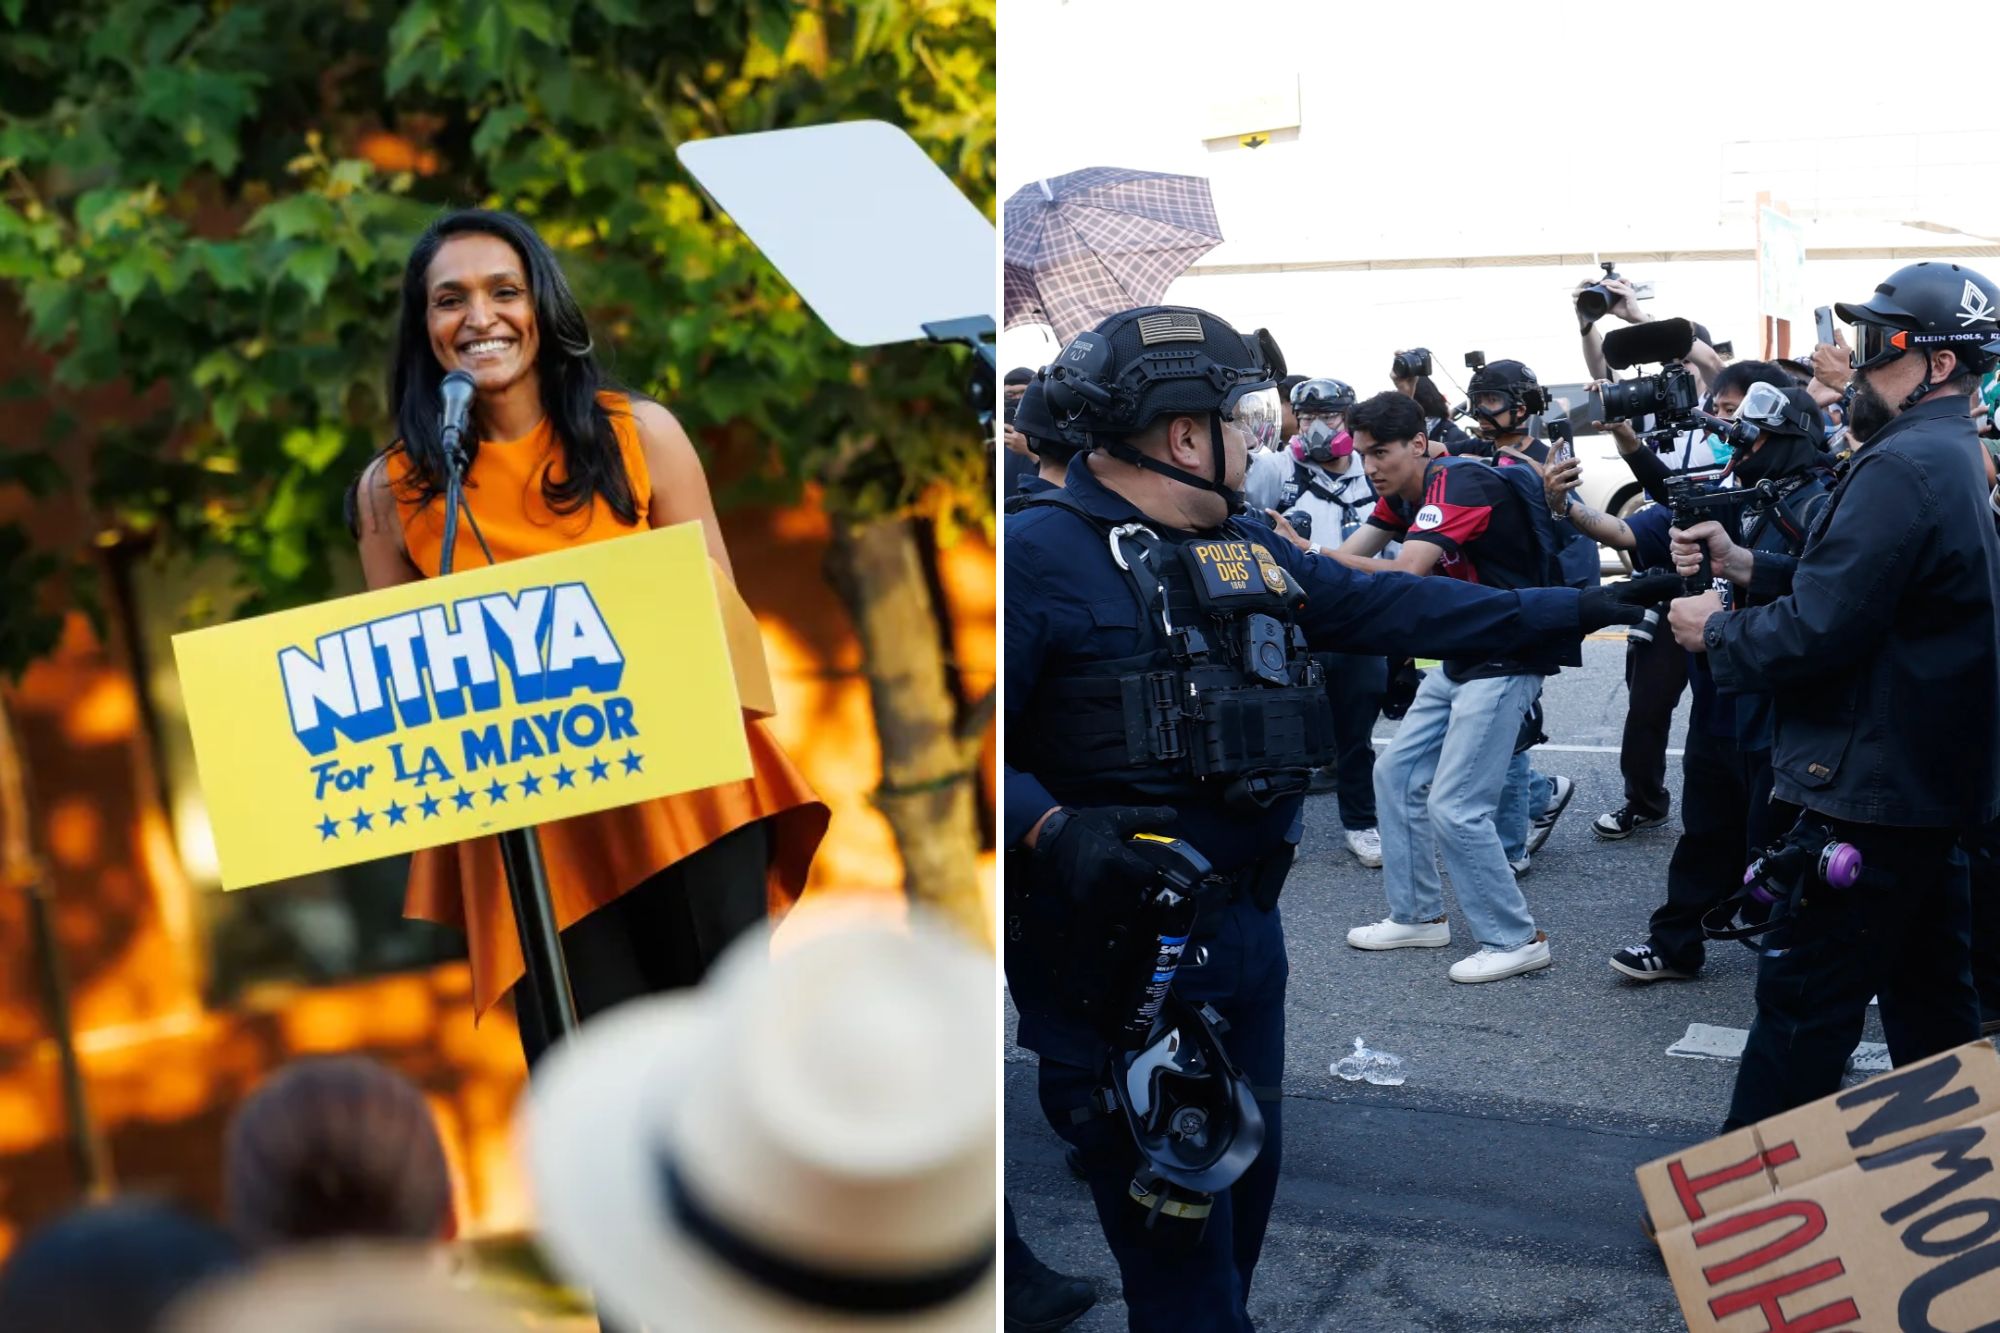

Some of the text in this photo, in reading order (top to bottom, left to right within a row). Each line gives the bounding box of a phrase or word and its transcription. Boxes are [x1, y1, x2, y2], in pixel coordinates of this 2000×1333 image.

[1195, 543, 1251, 564] POLICE
[1216, 561, 1249, 582] DHS
[277, 581, 626, 756] NITHYA
[310, 696, 639, 800] For LA MAYOR
[1667, 1139, 1861, 1333] HUT
